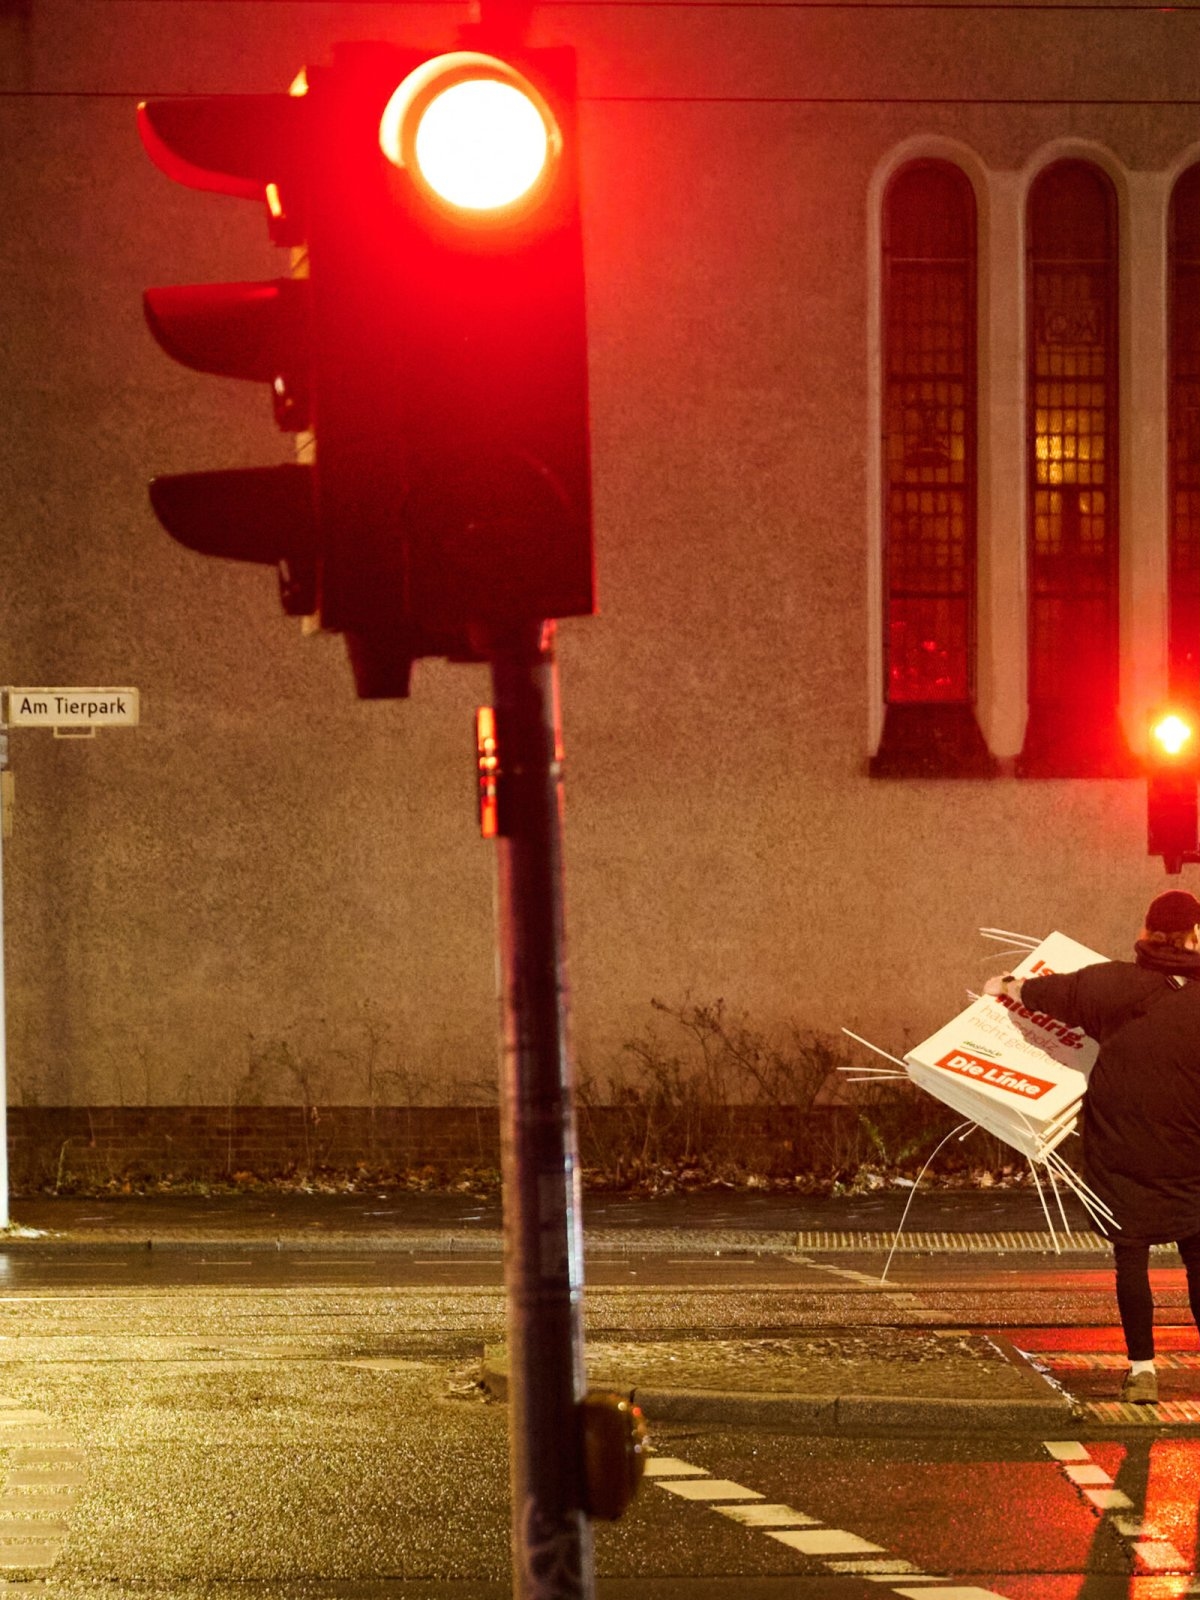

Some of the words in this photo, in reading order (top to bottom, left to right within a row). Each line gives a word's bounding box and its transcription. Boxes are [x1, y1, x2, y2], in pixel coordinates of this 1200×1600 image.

[20, 697, 48, 714] Am
[55, 696, 126, 718] Tierpark
[946, 1056, 985, 1078] Die
[981, 1069, 1042, 1096] Linke
